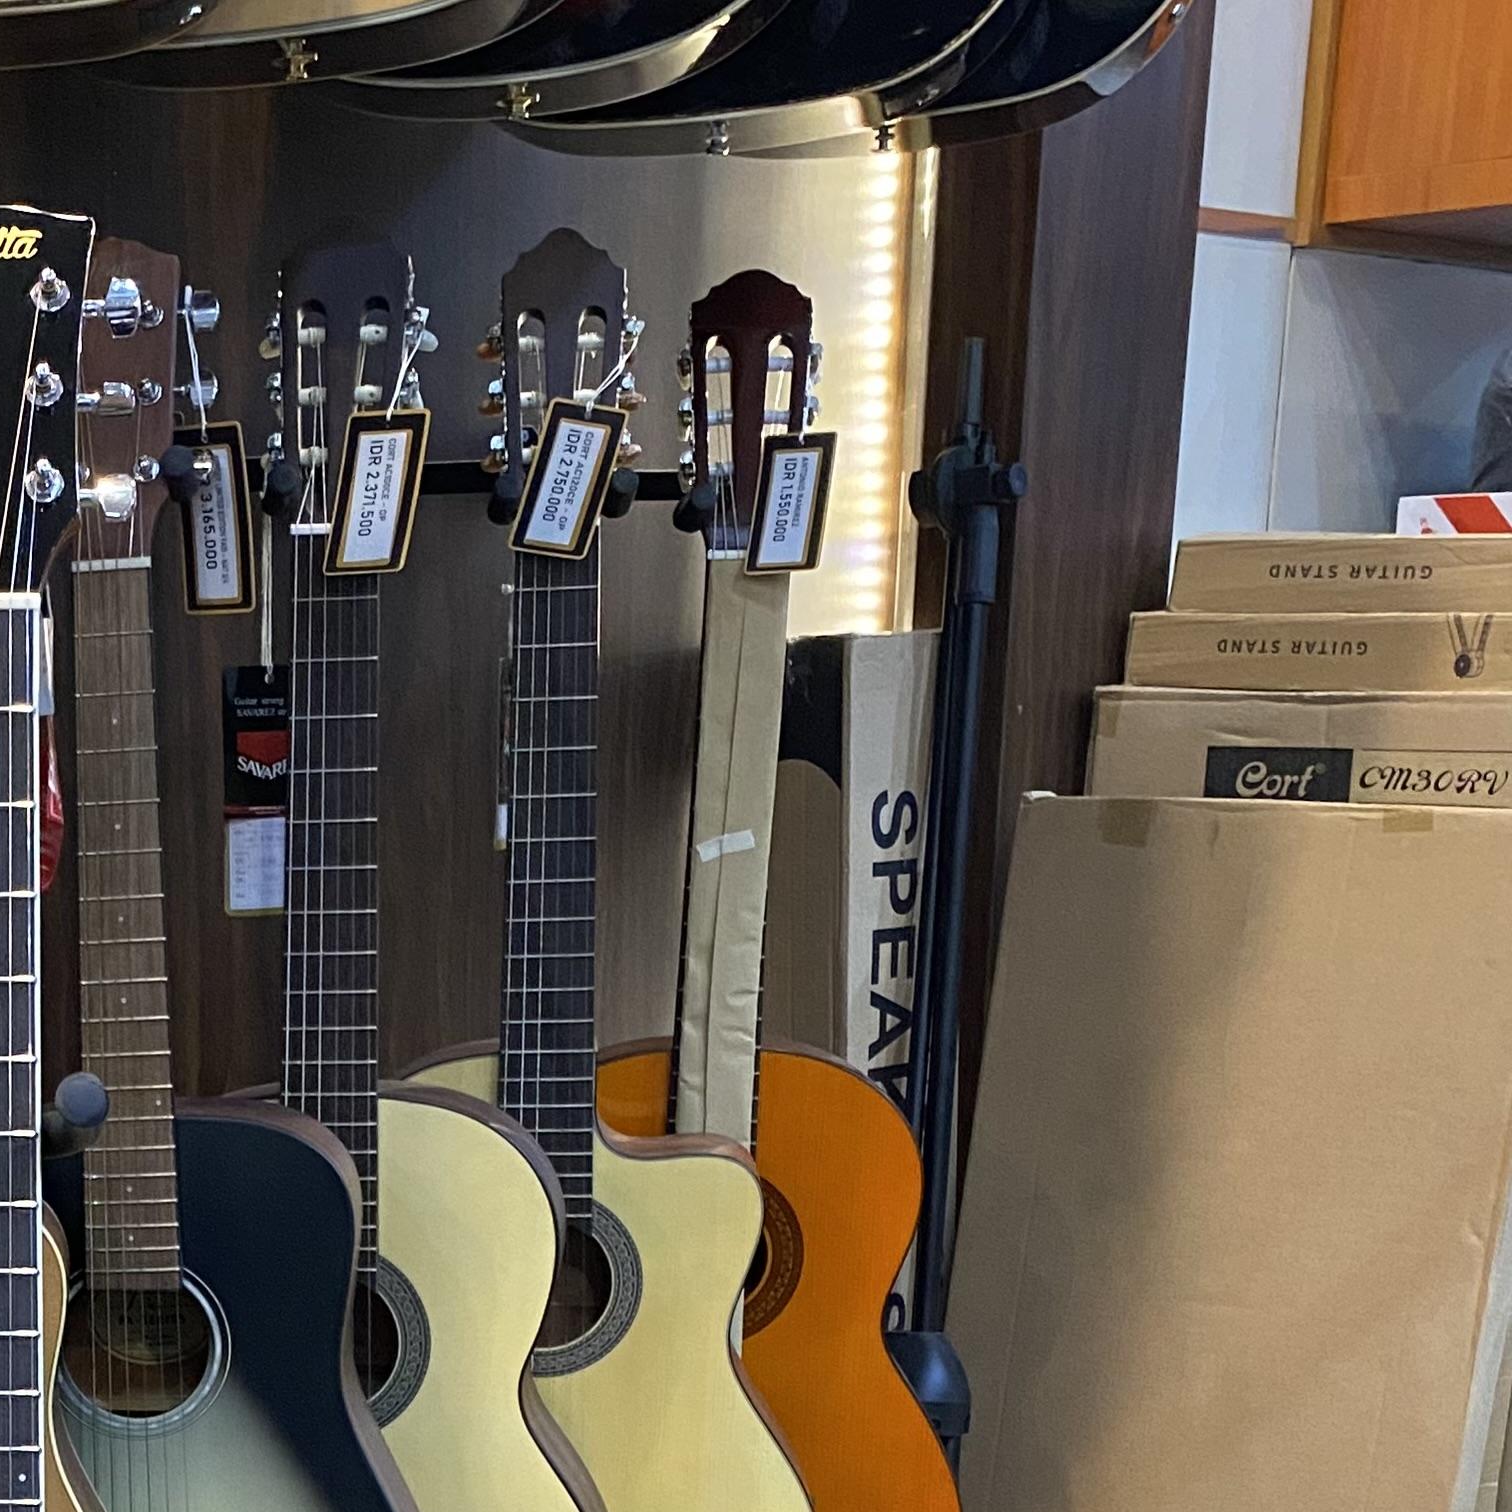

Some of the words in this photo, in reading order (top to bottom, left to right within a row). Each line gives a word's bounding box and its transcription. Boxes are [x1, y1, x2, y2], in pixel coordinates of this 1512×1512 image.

[368, 440, 384, 466] IDR
[563, 429, 582, 454] IDR
[582, 431, 594, 460] CORT
[783, 458, 797, 480] IDR
[543, 459, 572, 522] 2.750.000
[358, 472, 380, 537] 2.371.500
[773, 487, 793, 542] 1.550.000
[200, 493, 217, 569] 3.165.000
[1268, 564, 1339, 580] STAND
[1350, 564, 1434, 580] GUITAR
[1217, 639, 1281, 654] STAND
[1290, 640, 1368, 656] GUITAR
[1235, 761, 1312, 798] Cort
[1359, 765, 1509, 797] CM30RV
